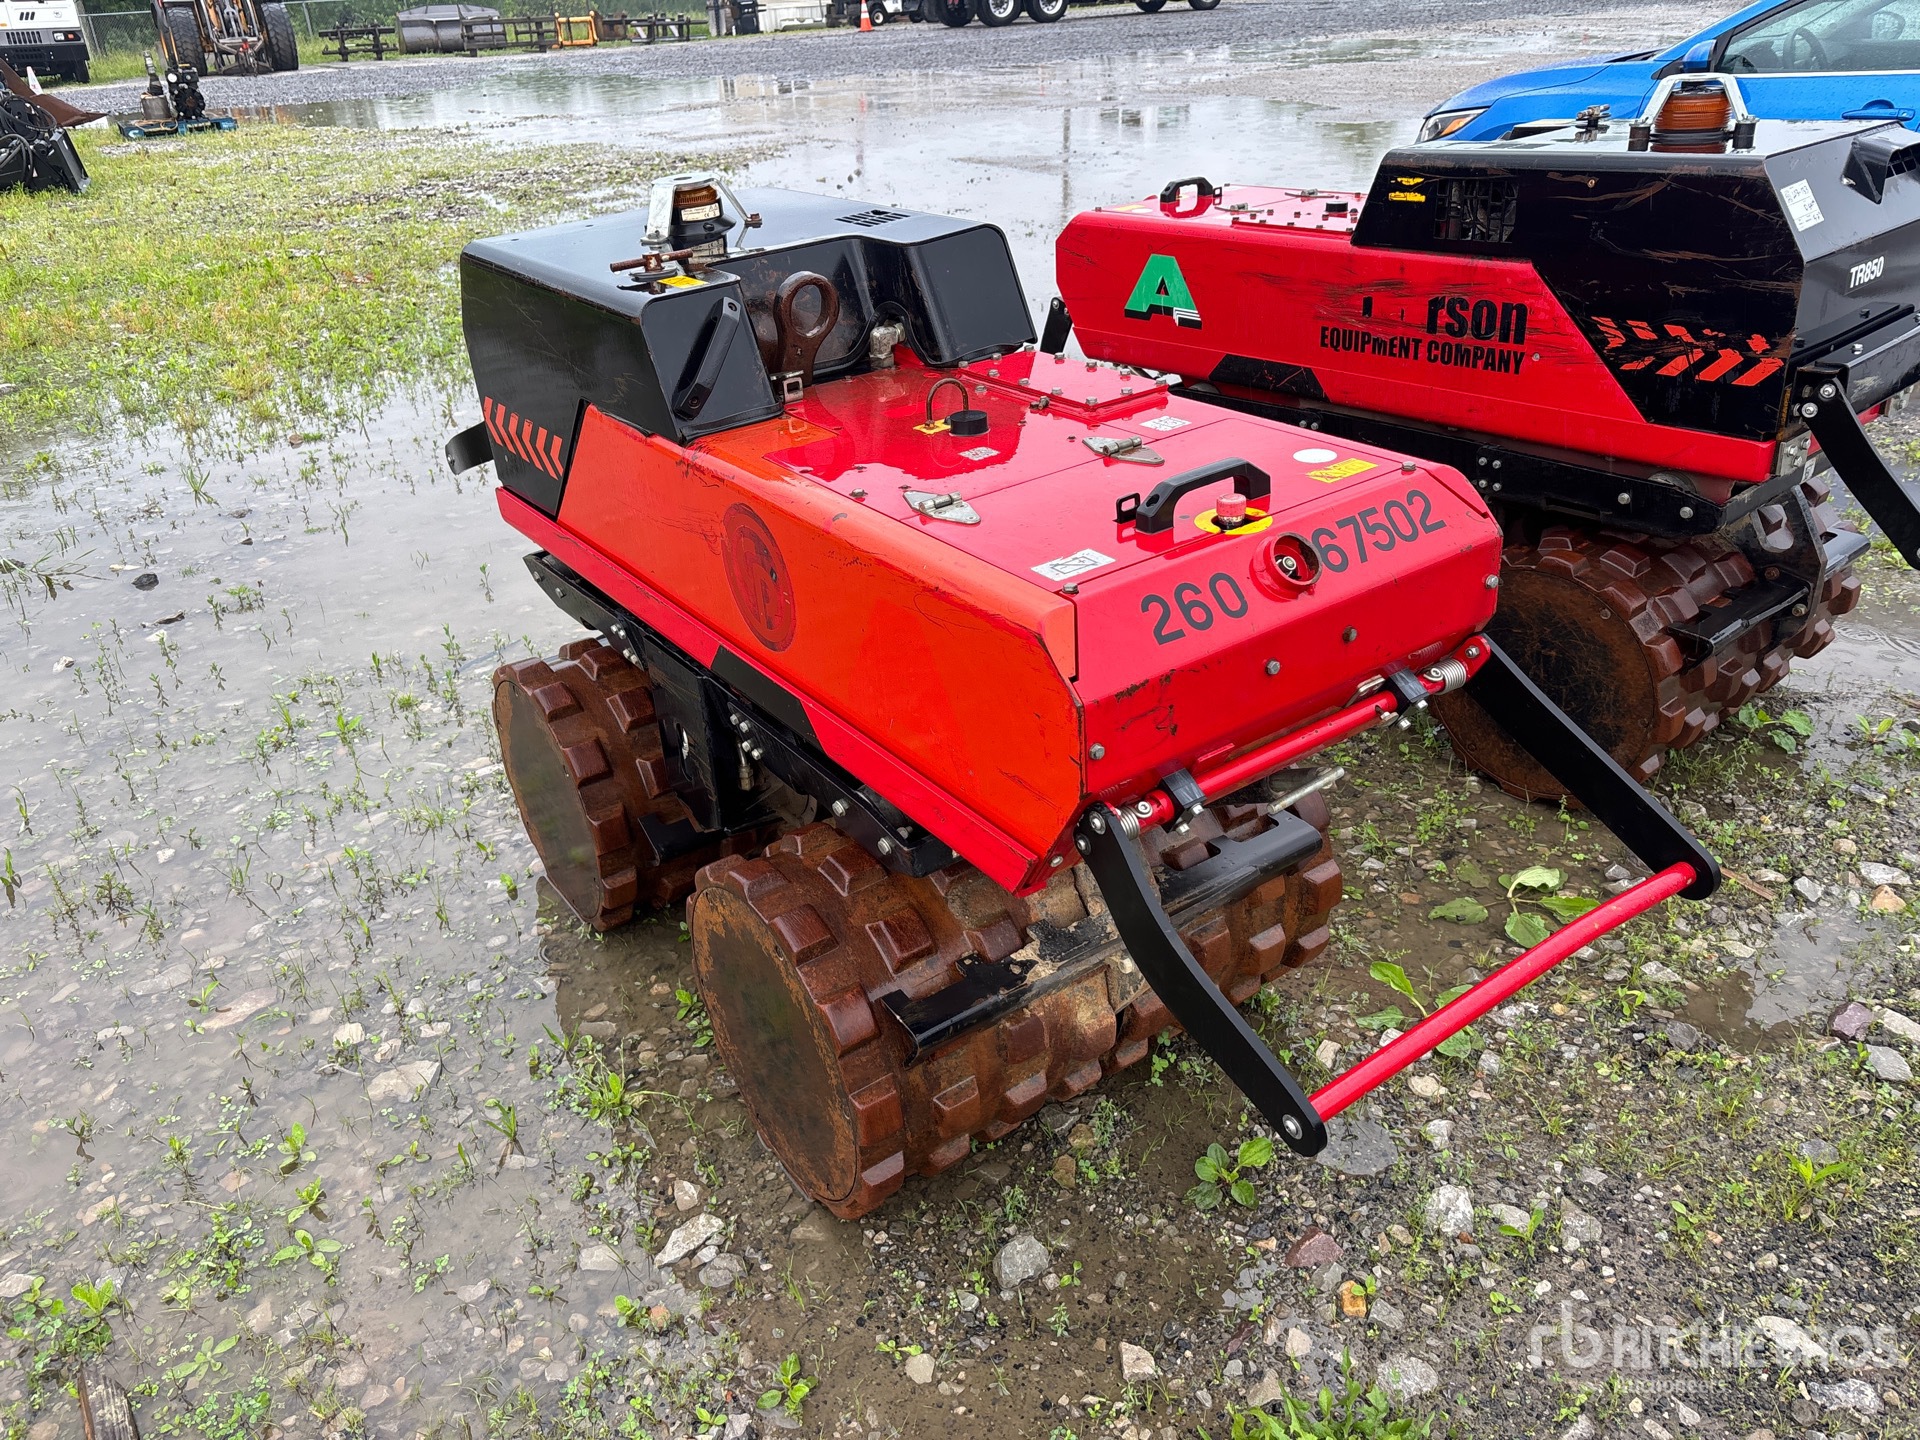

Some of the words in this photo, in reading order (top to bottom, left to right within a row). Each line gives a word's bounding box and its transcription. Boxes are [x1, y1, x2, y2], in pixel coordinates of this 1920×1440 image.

[1850, 256, 1885, 288] TR850
[1320, 326, 1422, 361] EQUIPMENT
[1426, 340, 1526, 375] COMPANY
[1140, 572, 1249, 646] 260
